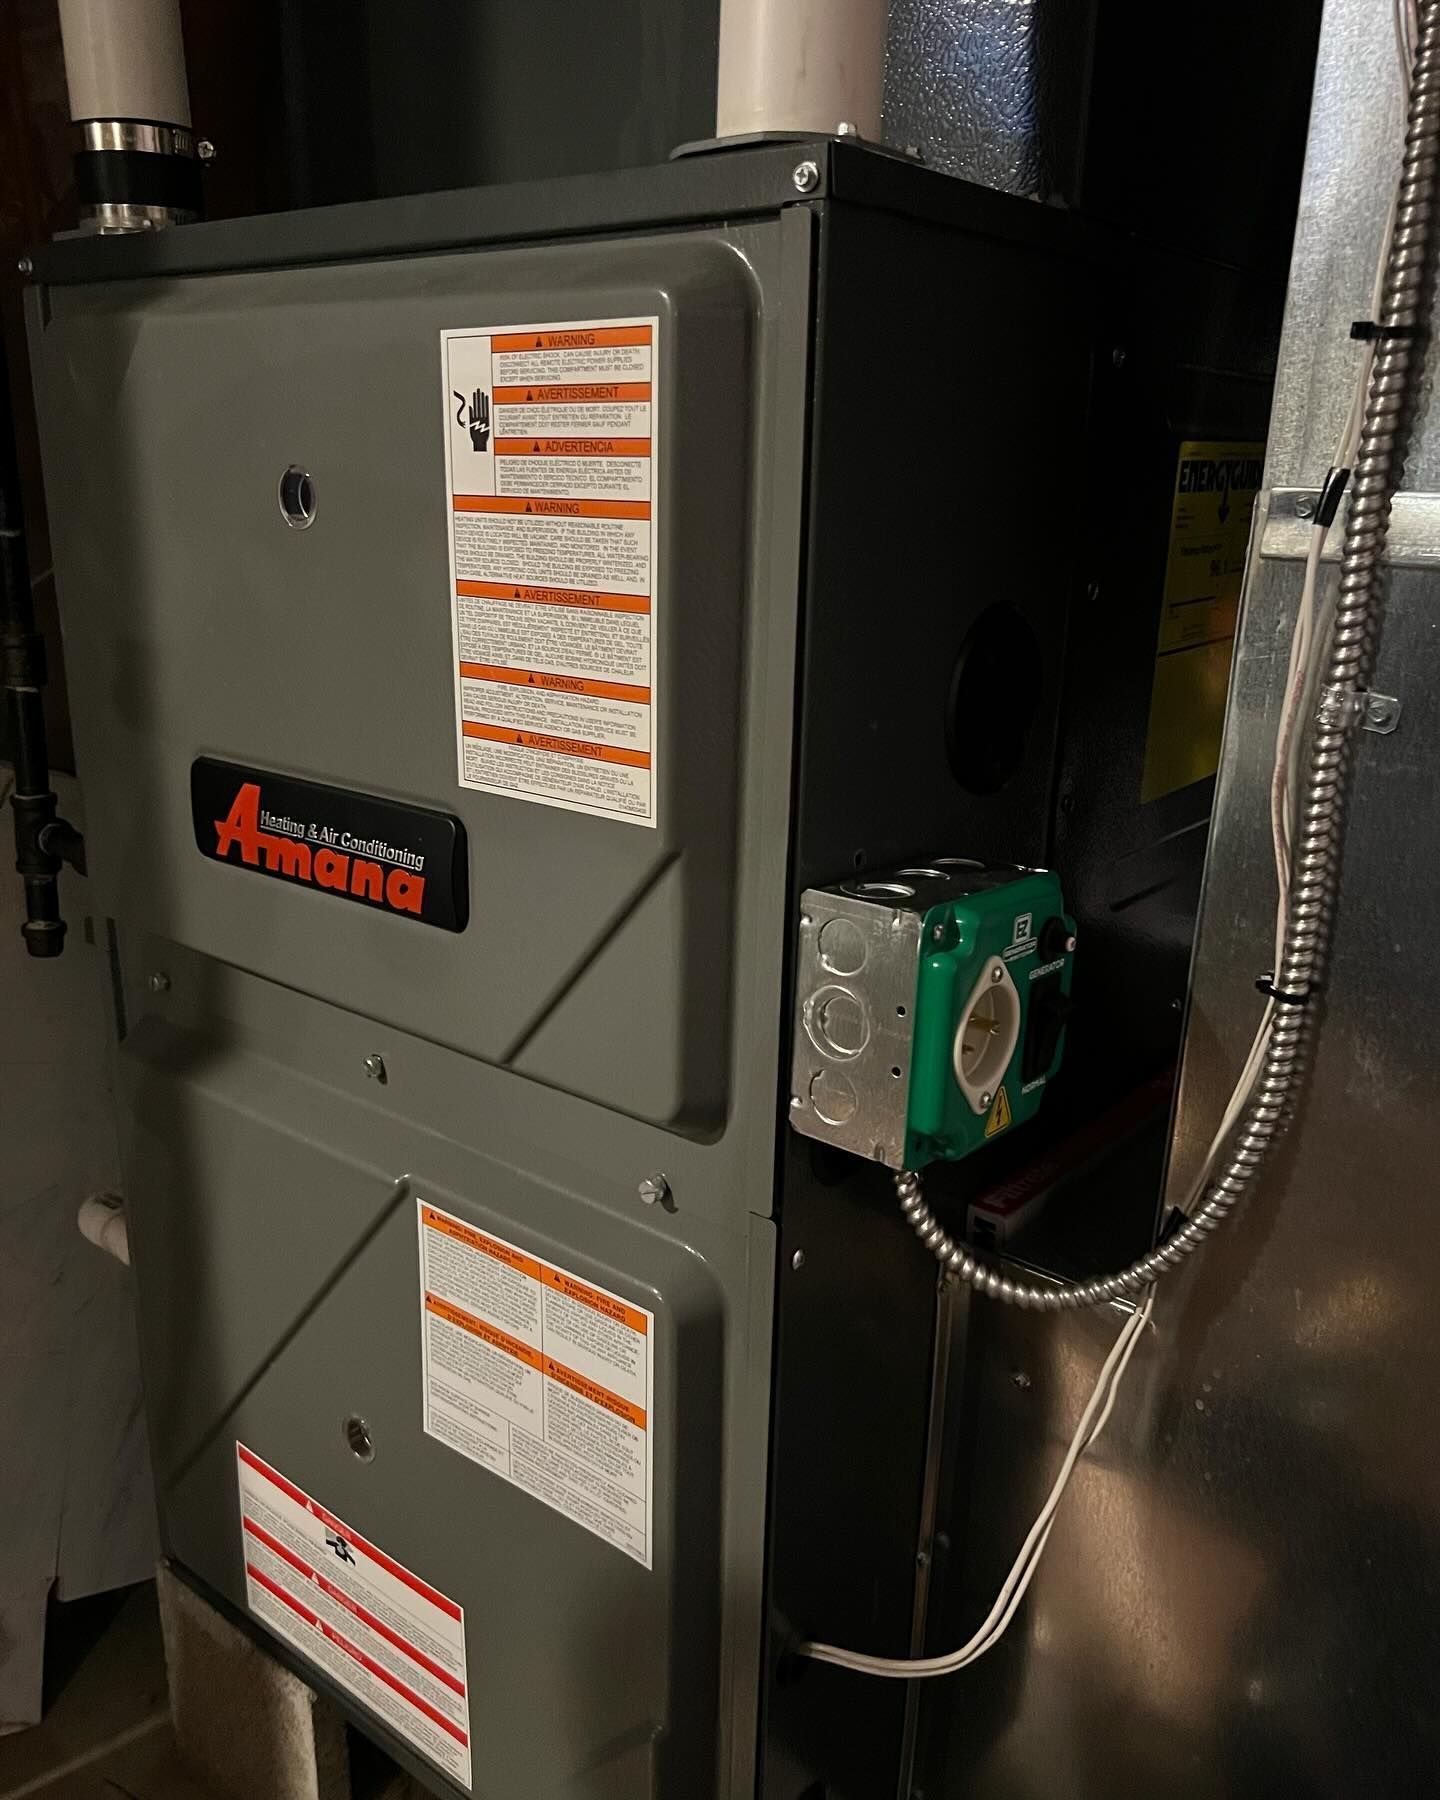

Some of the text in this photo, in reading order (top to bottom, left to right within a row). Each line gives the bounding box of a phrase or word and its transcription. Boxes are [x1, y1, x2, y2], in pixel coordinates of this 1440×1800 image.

[548, 333, 595, 346] WARNING
[537, 386, 618, 399] AVERTISSEMENT
[545, 441, 614, 452] ADVERTENCIA
[535, 501, 579, 513] WARNING
[523, 589, 600, 606] AVERTISSEMENT
[541, 675, 583, 691] WARNING
[528, 734, 602, 757] AVERTISSEMENT
[214, 782, 426, 915] Amana
[260, 810, 425, 871] Heating & Air Conditioning
